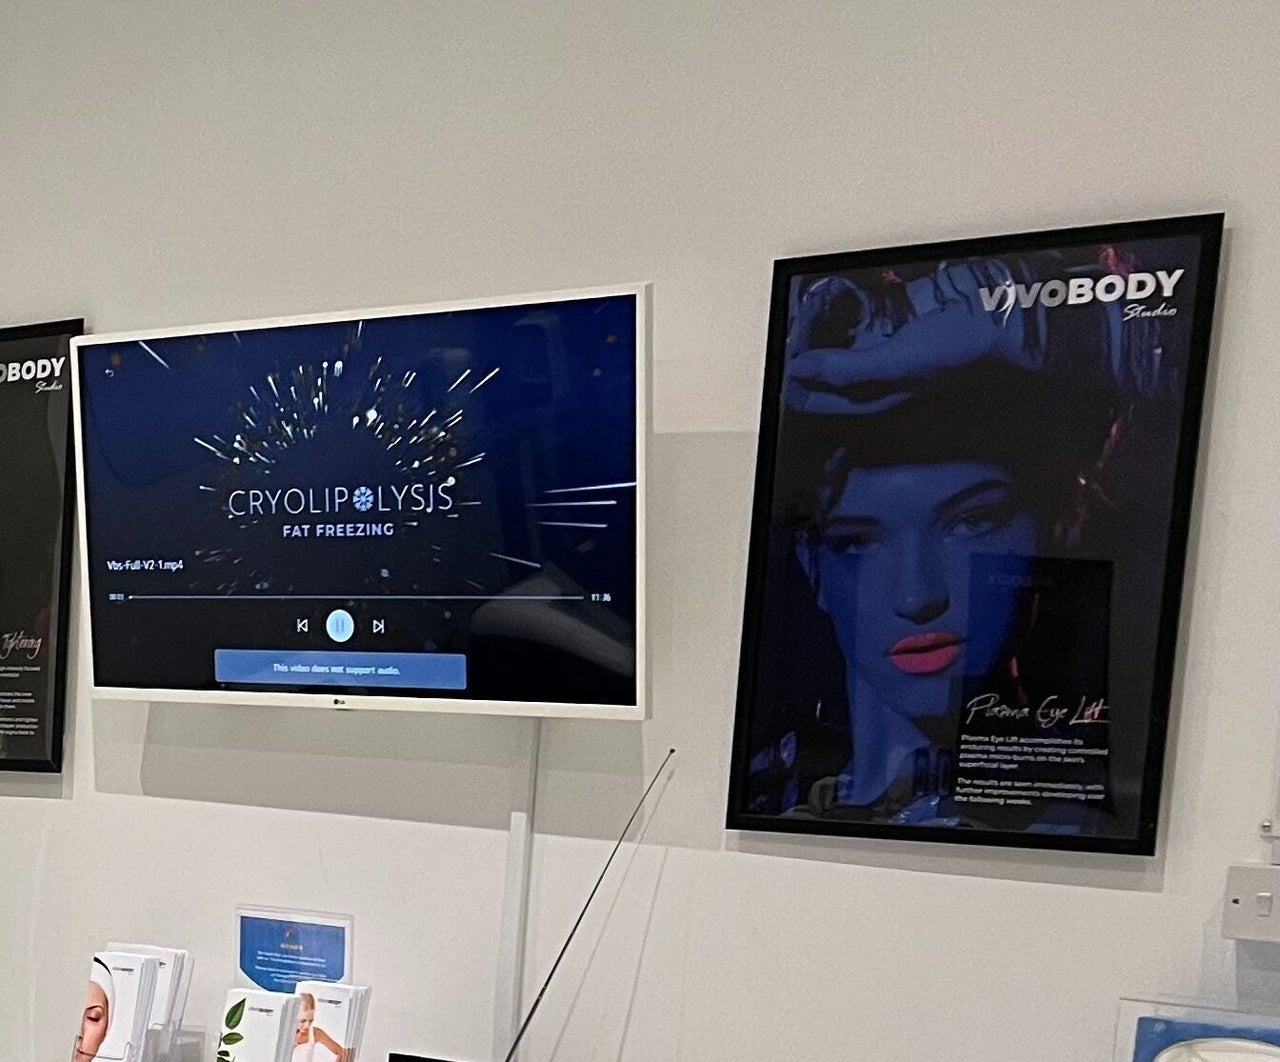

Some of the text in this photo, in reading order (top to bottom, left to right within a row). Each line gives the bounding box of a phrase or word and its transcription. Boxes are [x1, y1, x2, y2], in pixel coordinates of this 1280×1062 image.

[1123, 302, 1177, 321] Studio
[283, 523, 395, 538] FAT FREEZING
[273, 663, 288, 673] This
[290, 664, 310, 674] video
[311, 664, 329, 674] does
[346, 666, 376, 676] support
[966, 693, 1112, 728] Plasma Eye Lift
